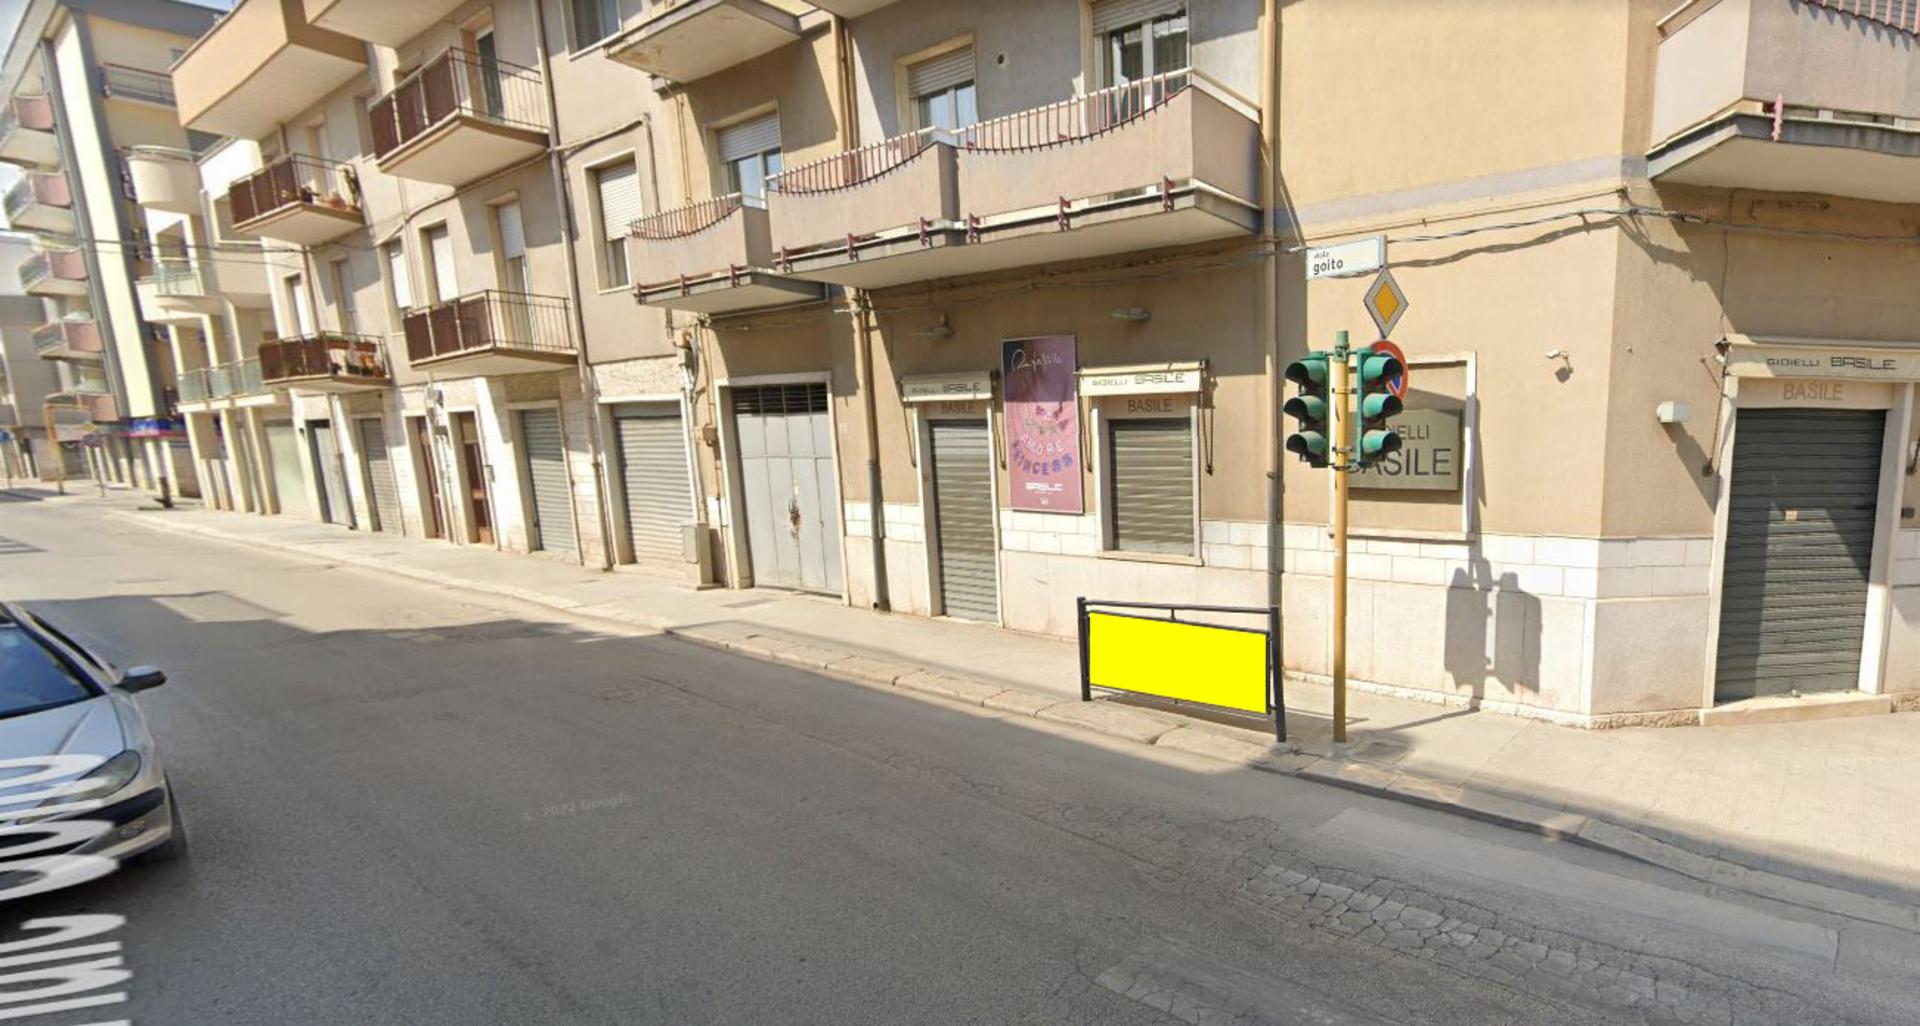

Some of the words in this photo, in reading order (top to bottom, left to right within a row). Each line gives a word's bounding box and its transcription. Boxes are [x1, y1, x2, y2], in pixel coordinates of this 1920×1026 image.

[1313, 259, 1344, 275] goito
[1766, 358, 1820, 367] GIOIELLI
[1830, 356, 1897, 370] BASILE
[1134, 373, 1185, 384] BASILE
[1783, 382, 1843, 401] BASILE
[1127, 398, 1173, 413] BASILE
